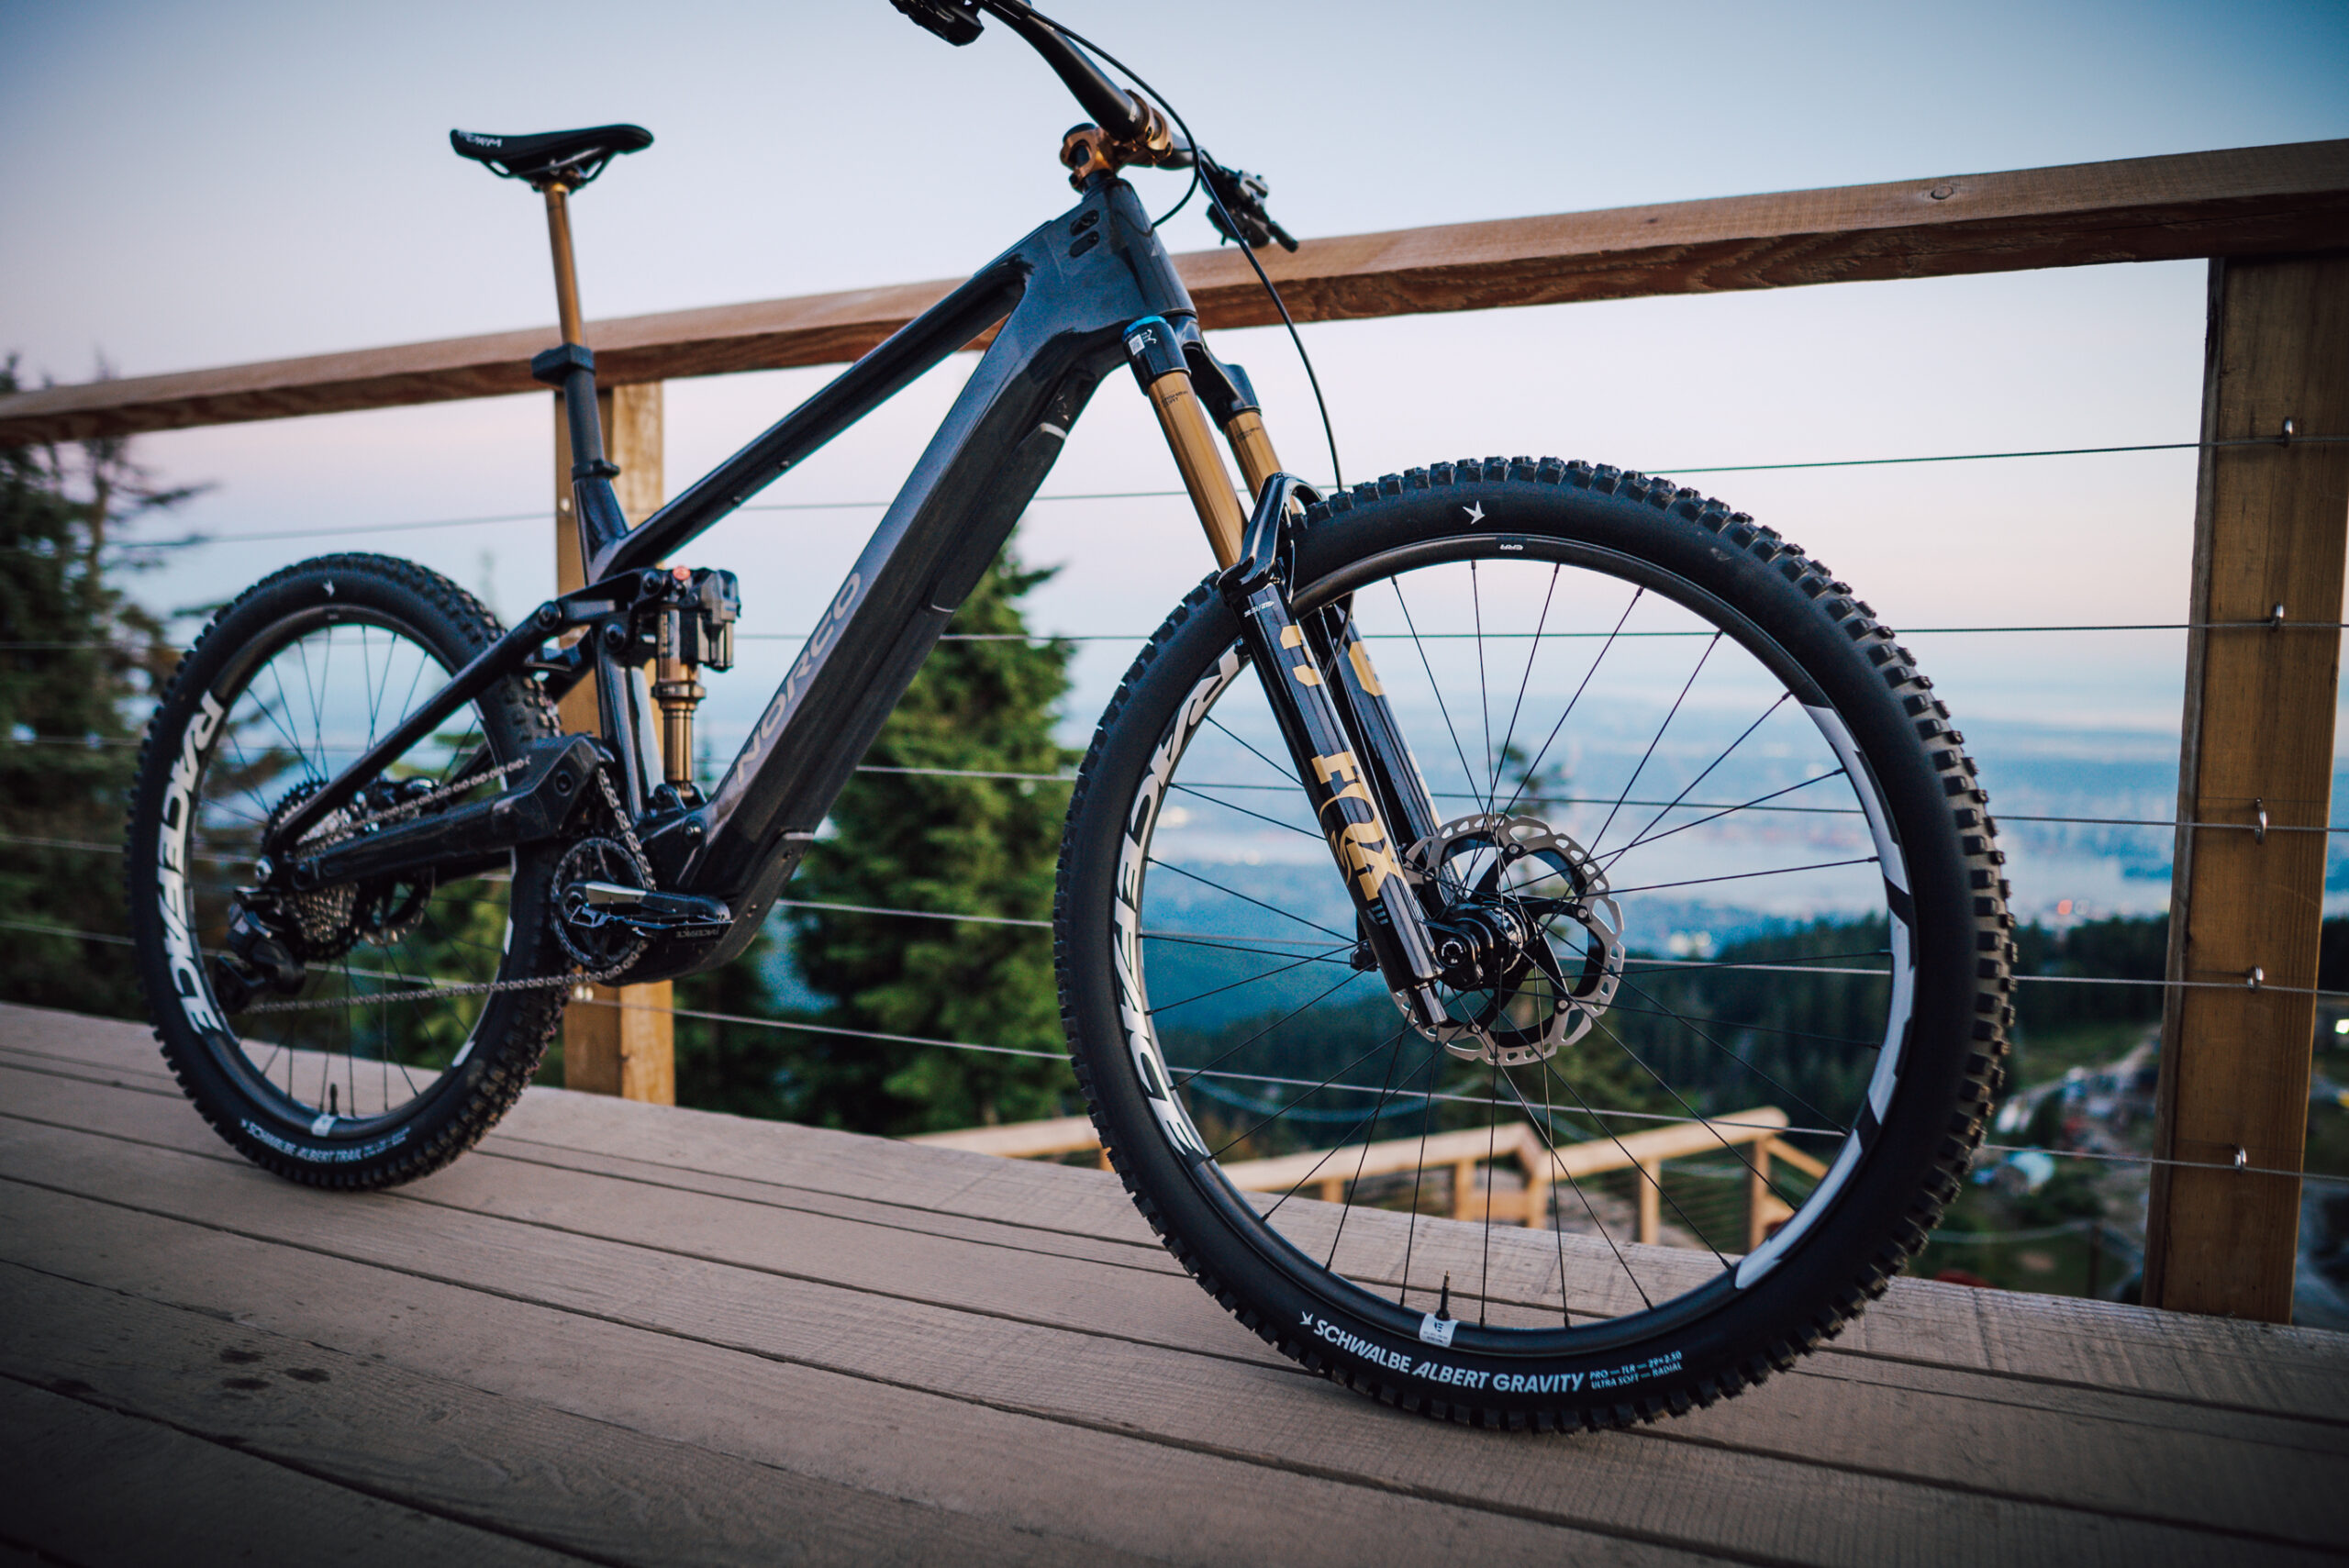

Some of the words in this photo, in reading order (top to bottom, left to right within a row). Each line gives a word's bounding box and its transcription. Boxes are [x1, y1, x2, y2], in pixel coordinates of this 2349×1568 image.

[736, 571, 862, 785] NORCO
[1311, 750, 1406, 902] FOX
[295, 1146, 334, 1164] ALBERT
[1313, 1318, 1412, 1372] SCHWALBE
[1411, 1362, 1490, 1389] ALBERT
[1493, 1372, 1585, 1394] GRAVITY
[1589, 1369, 1609, 1380] PRO
[1620, 1363, 1636, 1375] TLR
[1590, 1378, 1617, 1390] ULTRA
[1618, 1372, 1640, 1386] SOFT
[1652, 1361, 1683, 1378] RADIAL
